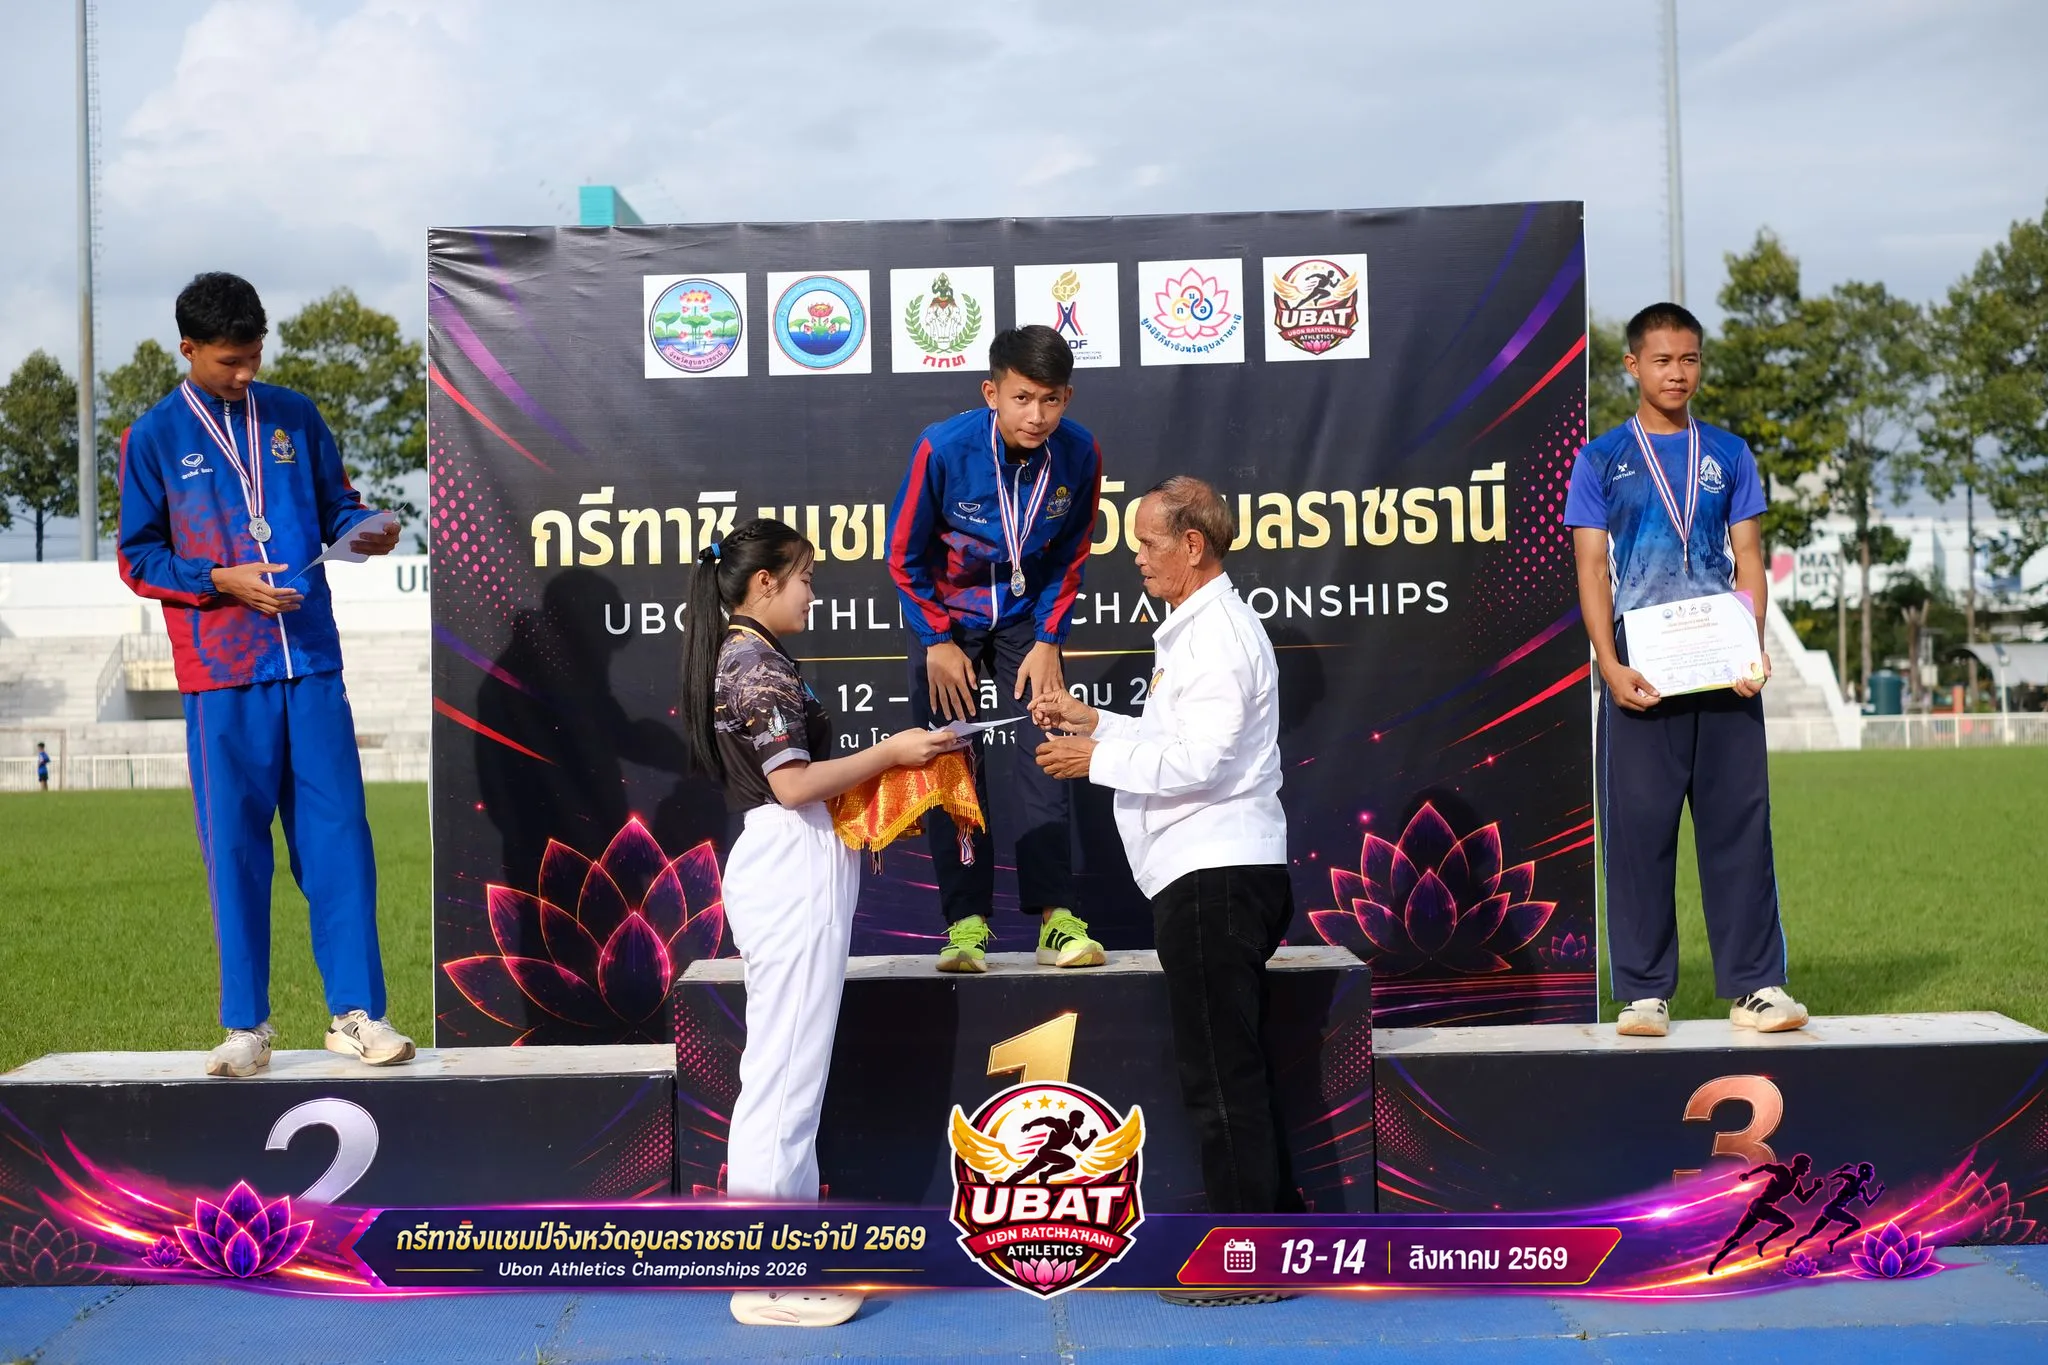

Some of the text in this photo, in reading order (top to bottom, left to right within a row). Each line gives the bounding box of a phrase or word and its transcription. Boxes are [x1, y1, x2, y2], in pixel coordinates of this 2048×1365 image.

[1281, 308, 1352, 328] UBAT
[923, 354, 966, 369] กกท
[837, 683, 874, 712] 12
[265, 1097, 380, 1204] 2
